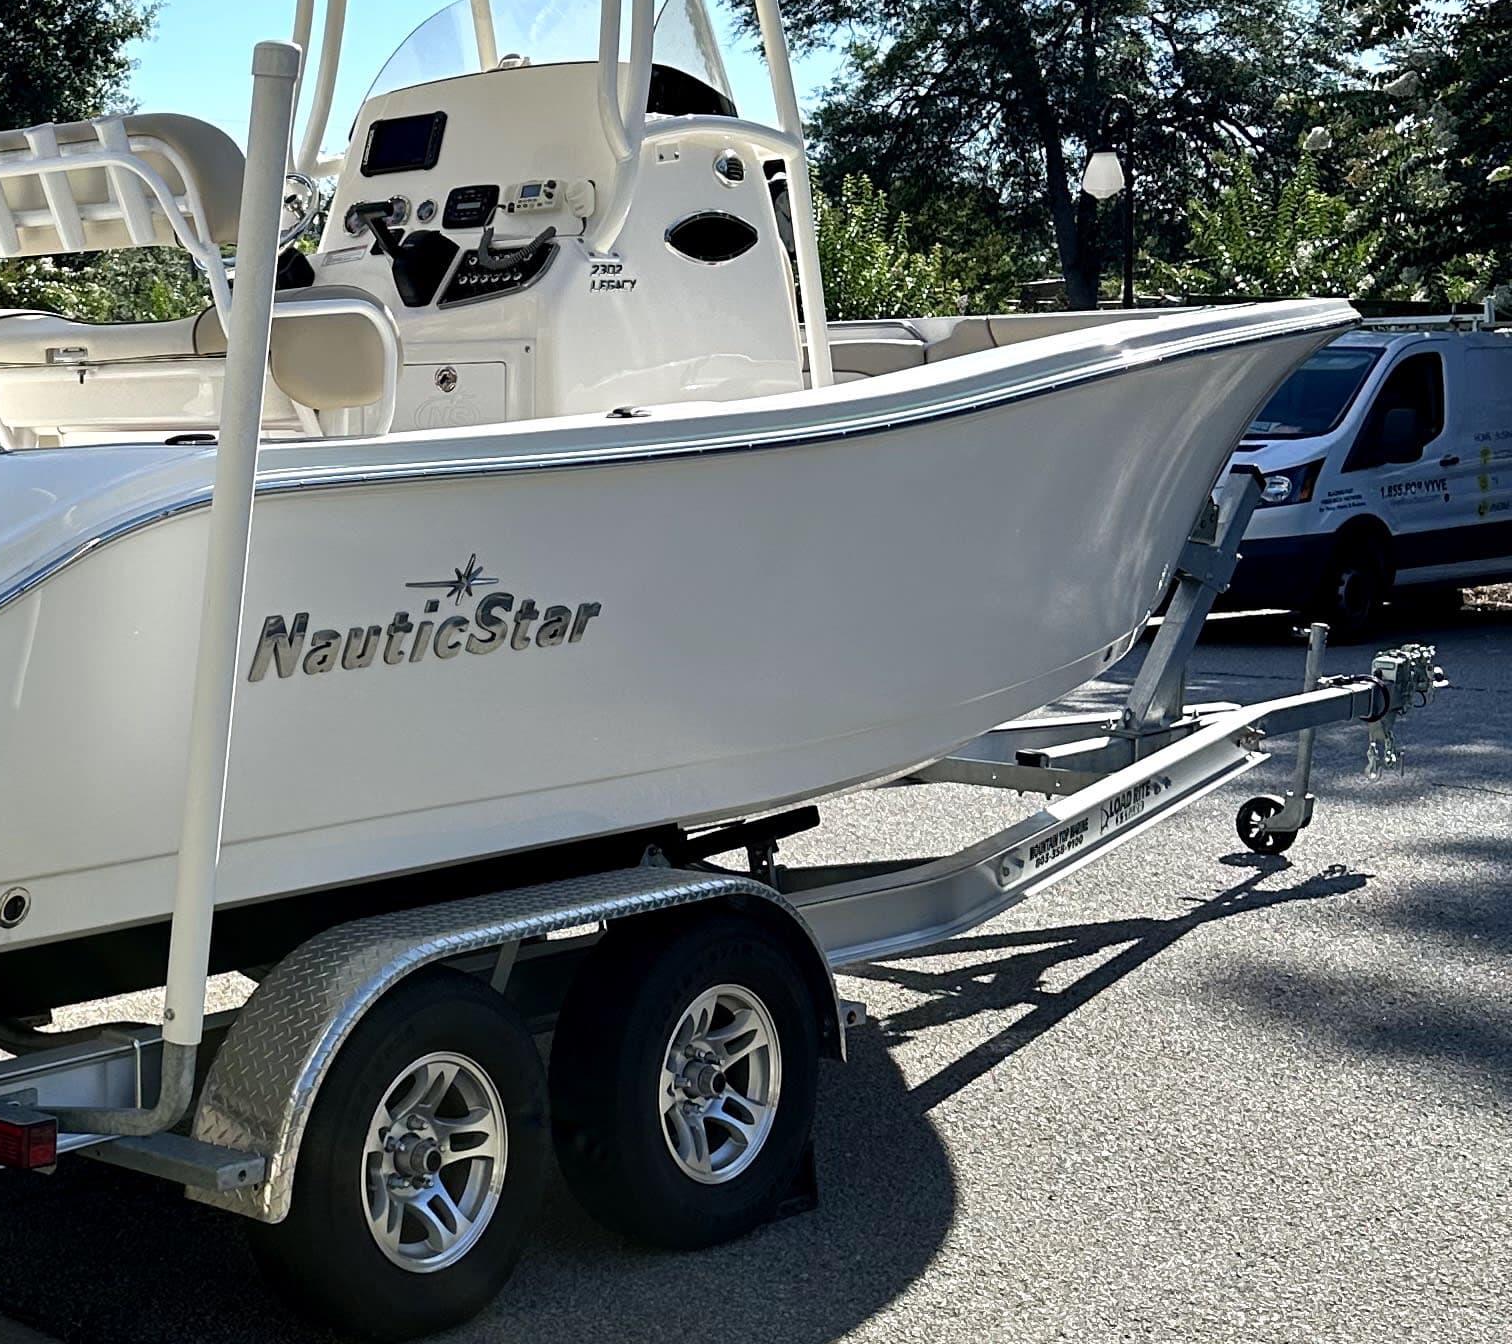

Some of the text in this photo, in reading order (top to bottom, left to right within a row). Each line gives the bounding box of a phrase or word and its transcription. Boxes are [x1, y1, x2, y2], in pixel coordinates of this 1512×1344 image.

[591, 264, 622, 275] 2302
[591, 279, 637, 291] LEGACY
[1424, 478, 1448, 492] VYVE
[248, 591, 602, 663] NauticStar
[1109, 789, 1133, 817] LOAD
[1133, 779, 1151, 804] RITE
